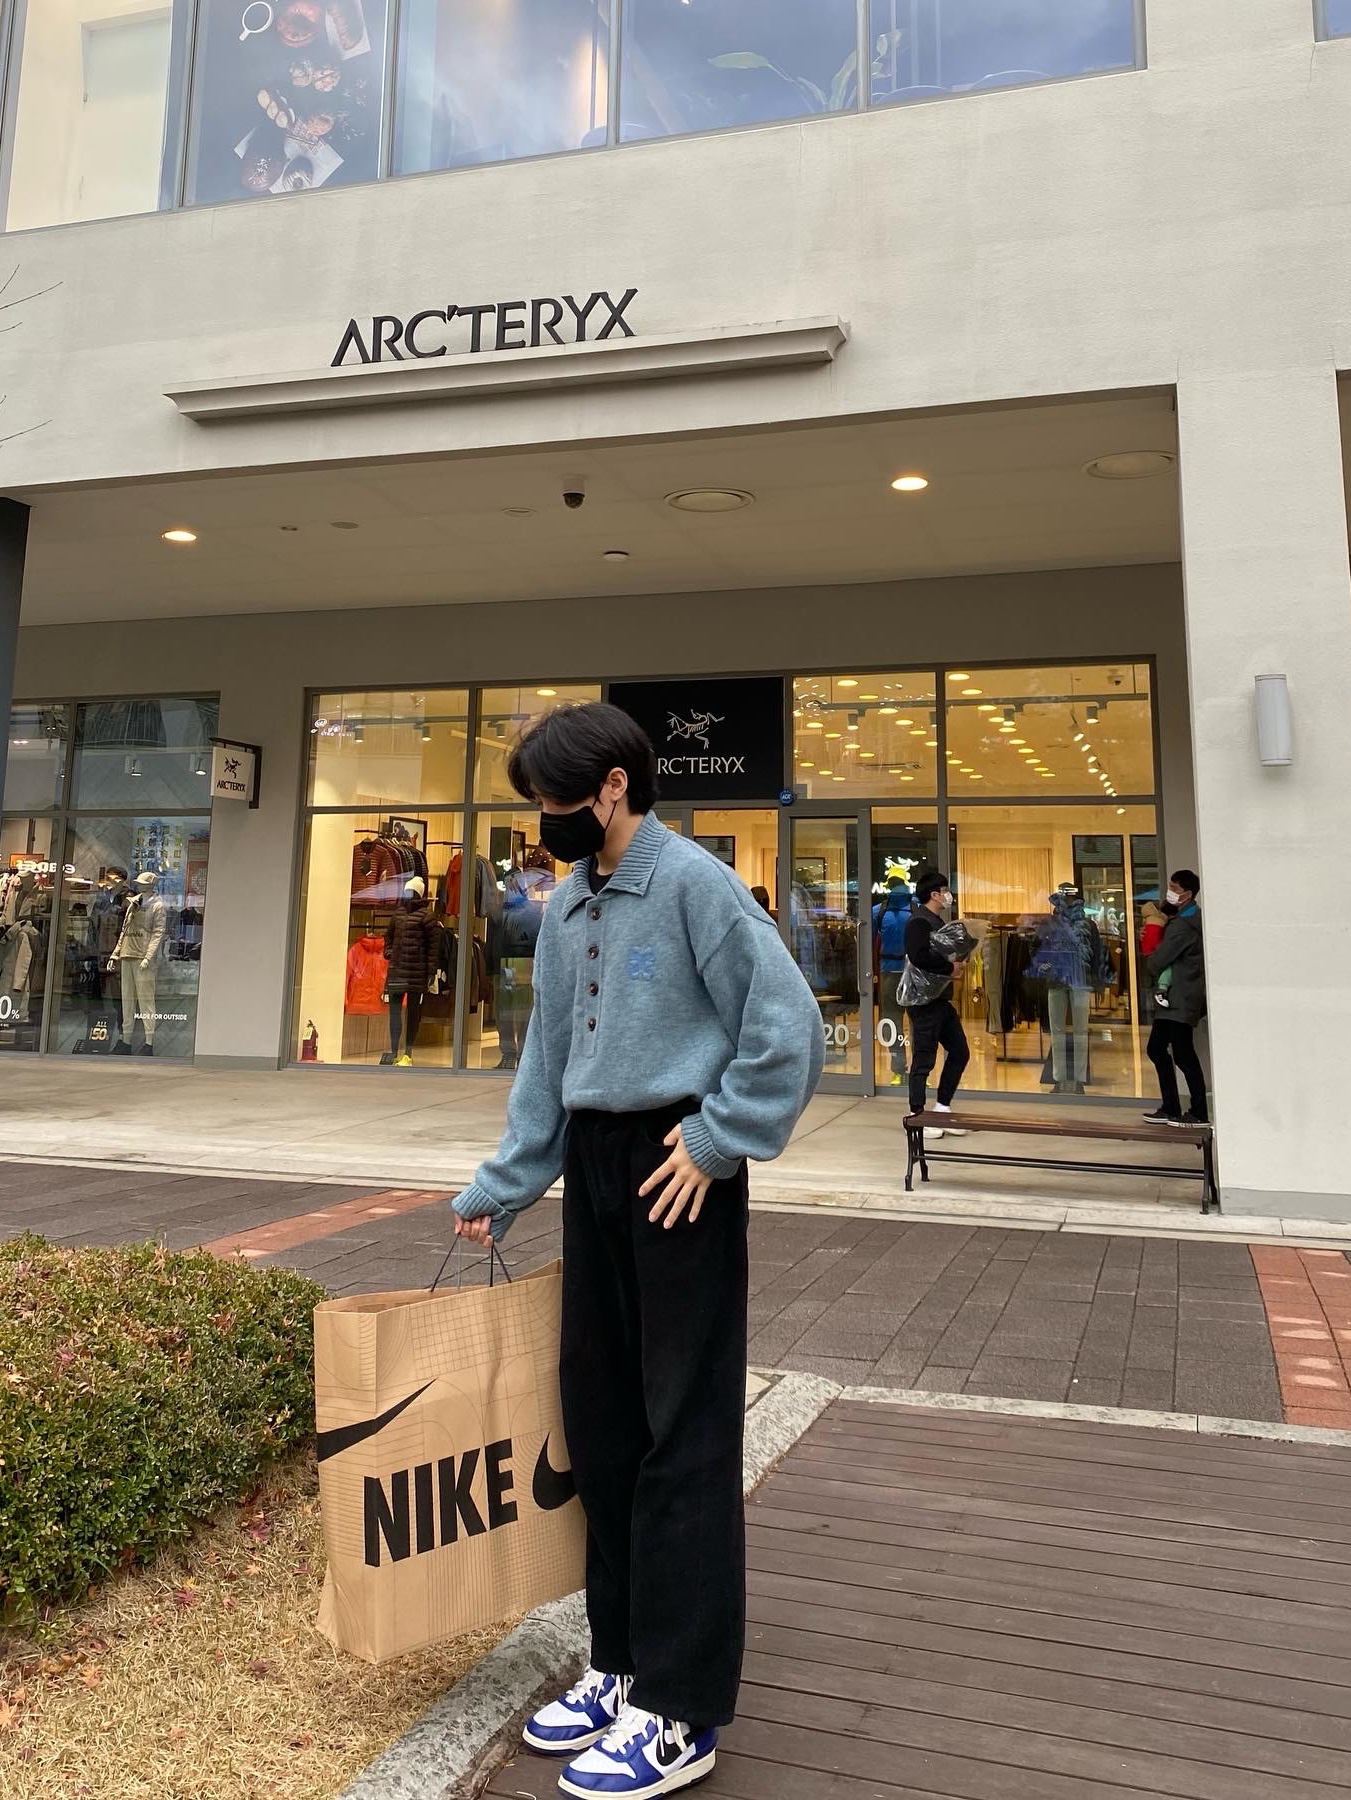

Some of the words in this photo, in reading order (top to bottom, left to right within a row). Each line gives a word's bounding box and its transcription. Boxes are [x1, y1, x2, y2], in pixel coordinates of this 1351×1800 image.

[330, 288, 638, 367] ARC'TERYX
[657, 756, 745, 774] RC'TERYX
[133, 1012, 150, 1020] MADE
[163, 1013, 187, 1021] OUTSIDE
[364, 1438, 518, 1567] NIKE
